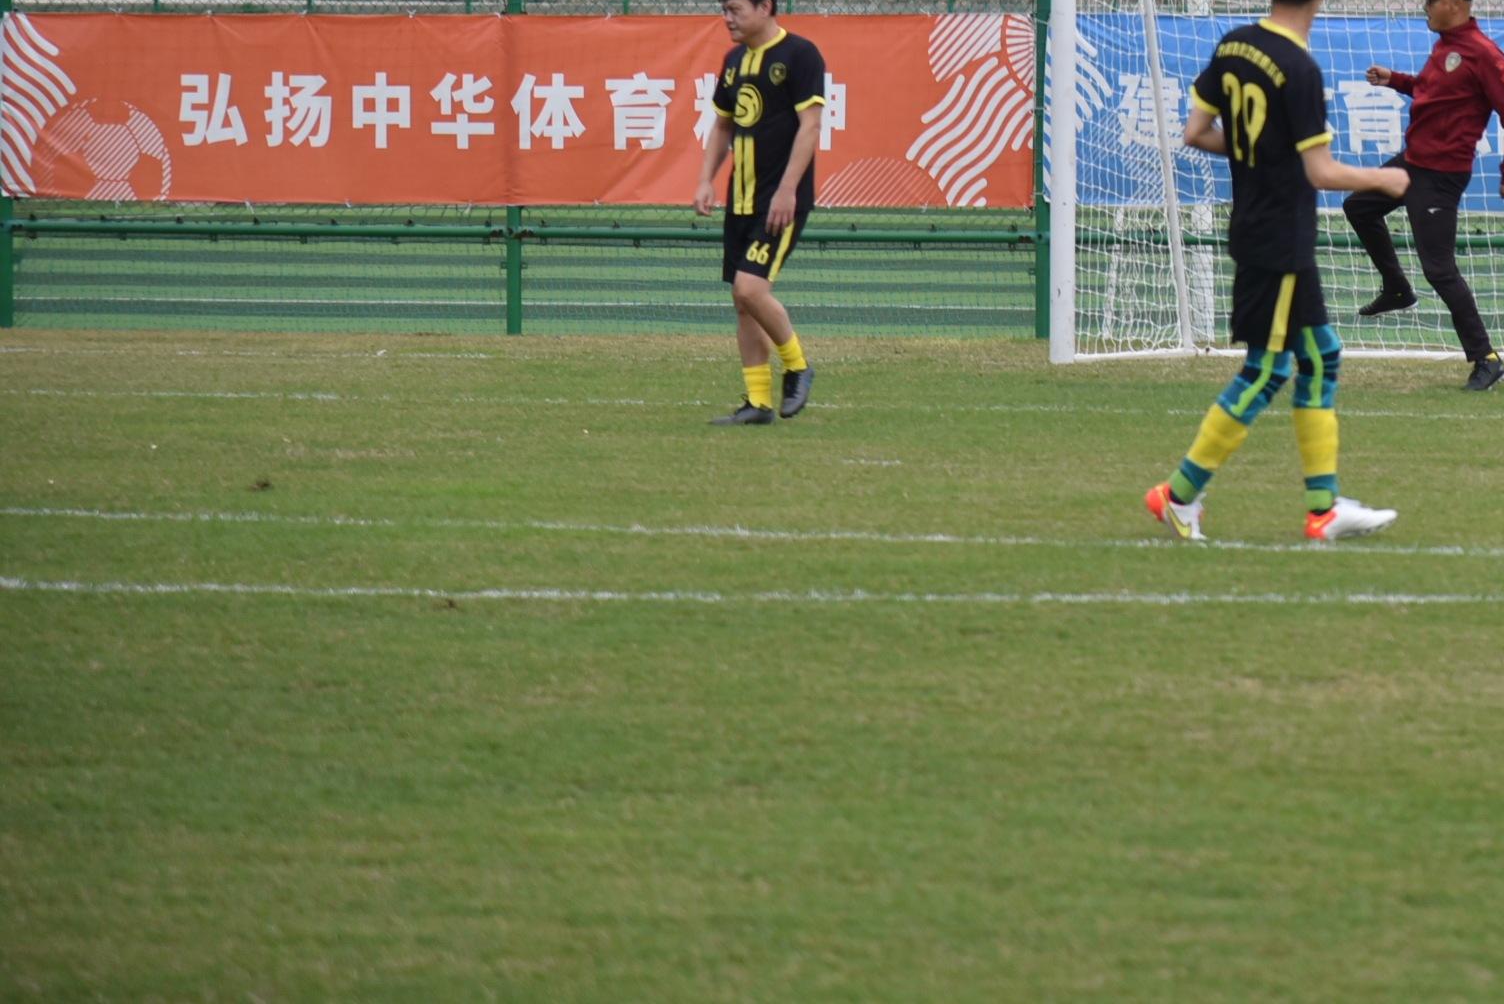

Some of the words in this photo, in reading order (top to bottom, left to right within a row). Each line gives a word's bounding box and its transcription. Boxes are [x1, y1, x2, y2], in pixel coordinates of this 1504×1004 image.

[179, 70, 847, 151] 弘扬中华体育
[746, 240, 770, 265] 66
